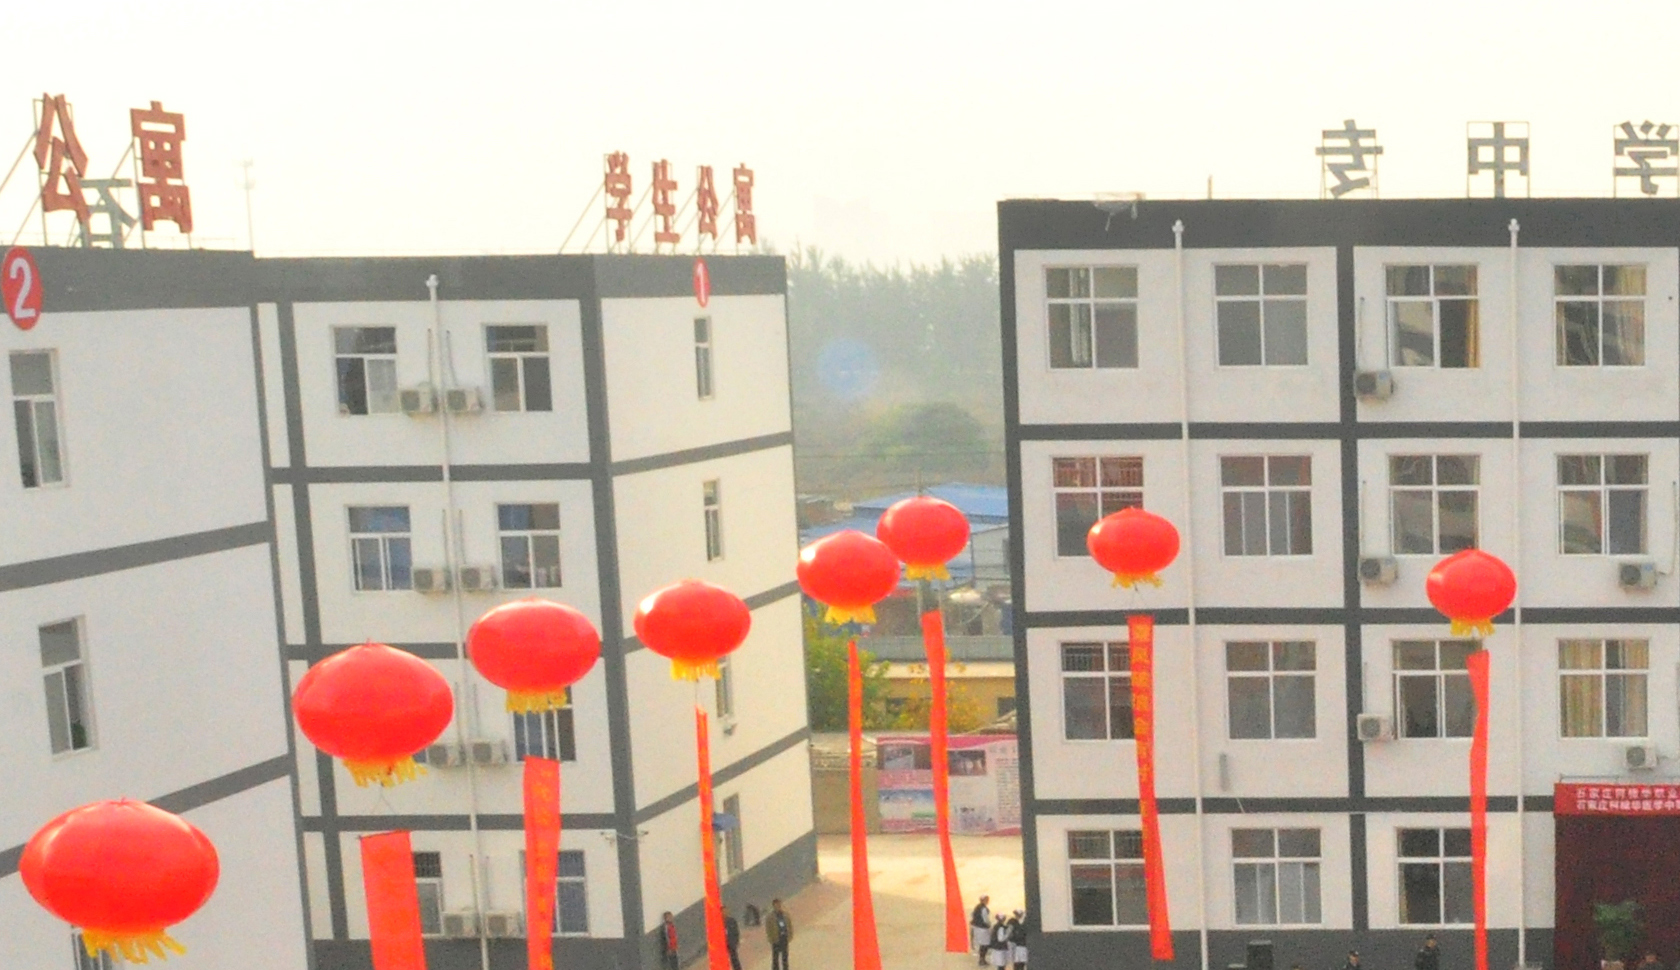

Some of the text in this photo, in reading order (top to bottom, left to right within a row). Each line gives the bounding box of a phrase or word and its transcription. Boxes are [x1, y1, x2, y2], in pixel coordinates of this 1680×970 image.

[33, 92, 193, 234] 公寓
[605, 149, 757, 246] 学生公寓
[10, 257, 36, 319] 2
[696, 262, 706, 305] 1
